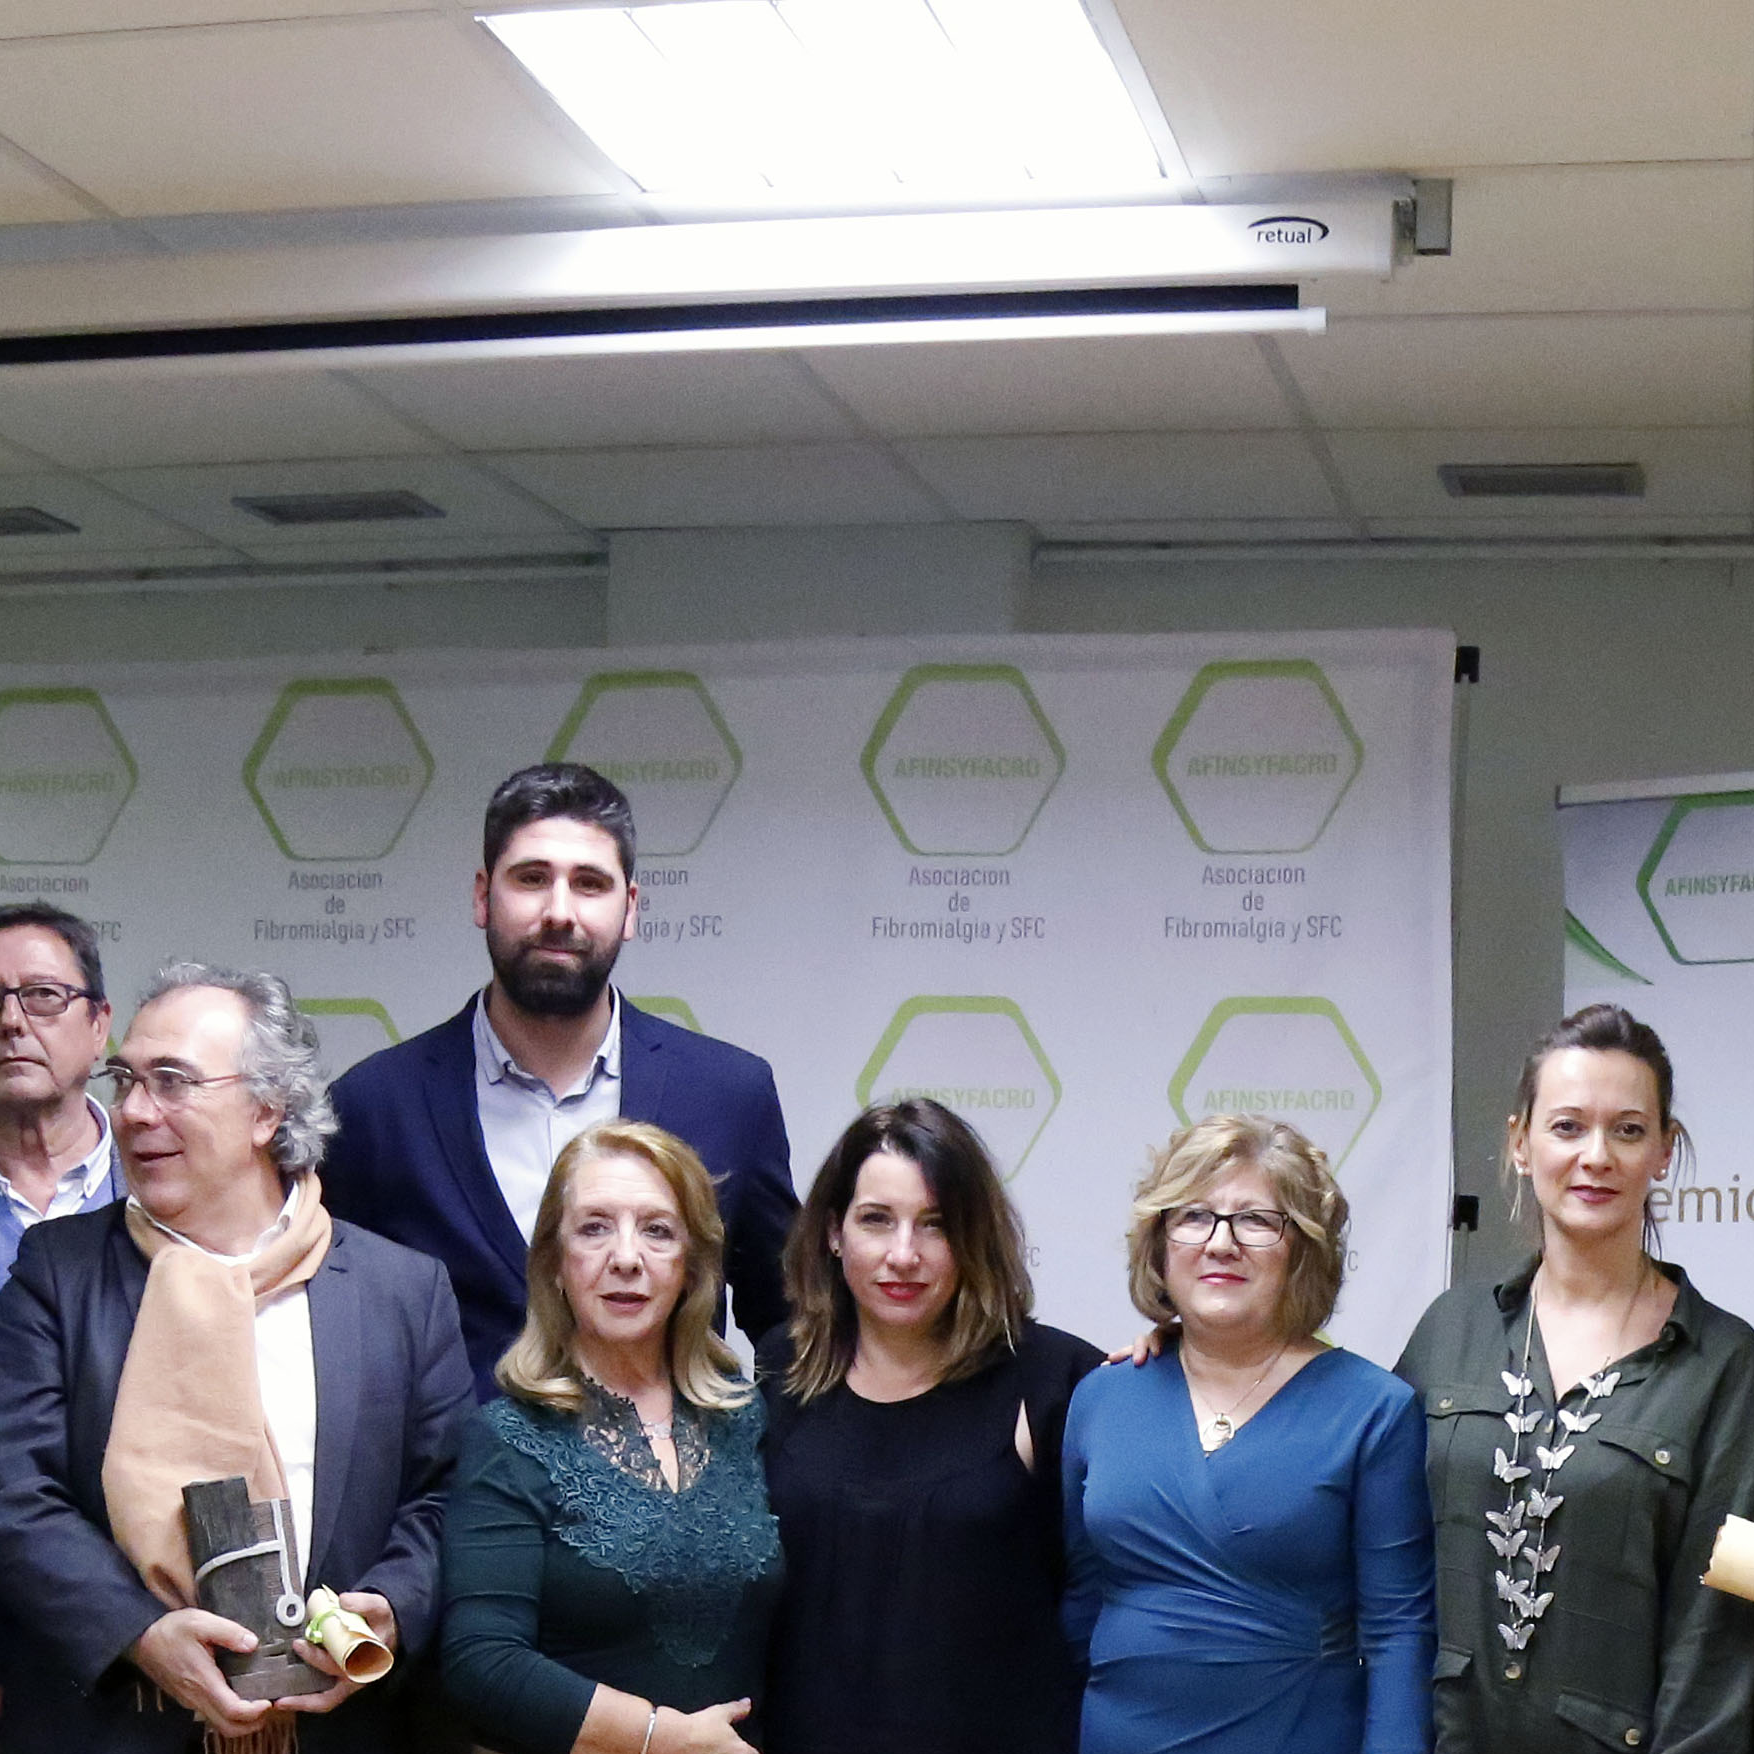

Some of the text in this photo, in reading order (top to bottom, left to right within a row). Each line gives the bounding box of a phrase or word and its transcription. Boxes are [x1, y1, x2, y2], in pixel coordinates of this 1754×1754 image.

[1257, 227, 1312, 244] retual
[894, 757, 1041, 779] AFINSYFACRO
[1187, 754, 1338, 777] AFINSYFACRO
[324, 895, 346, 915] de
[948, 892, 970, 912] de
[1242, 891, 1264, 911] de
[254, 917, 416, 944] Fibromialgia y SFC
[675, 921, 685, 943] y
[690, 914, 723, 937] SFC
[871, 916, 1046, 944] Fibromialgia y SFC
[1164, 915, 1342, 943] Fibromialgia y SFC
[1203, 1089, 1356, 1112] AFINSYFACRO
